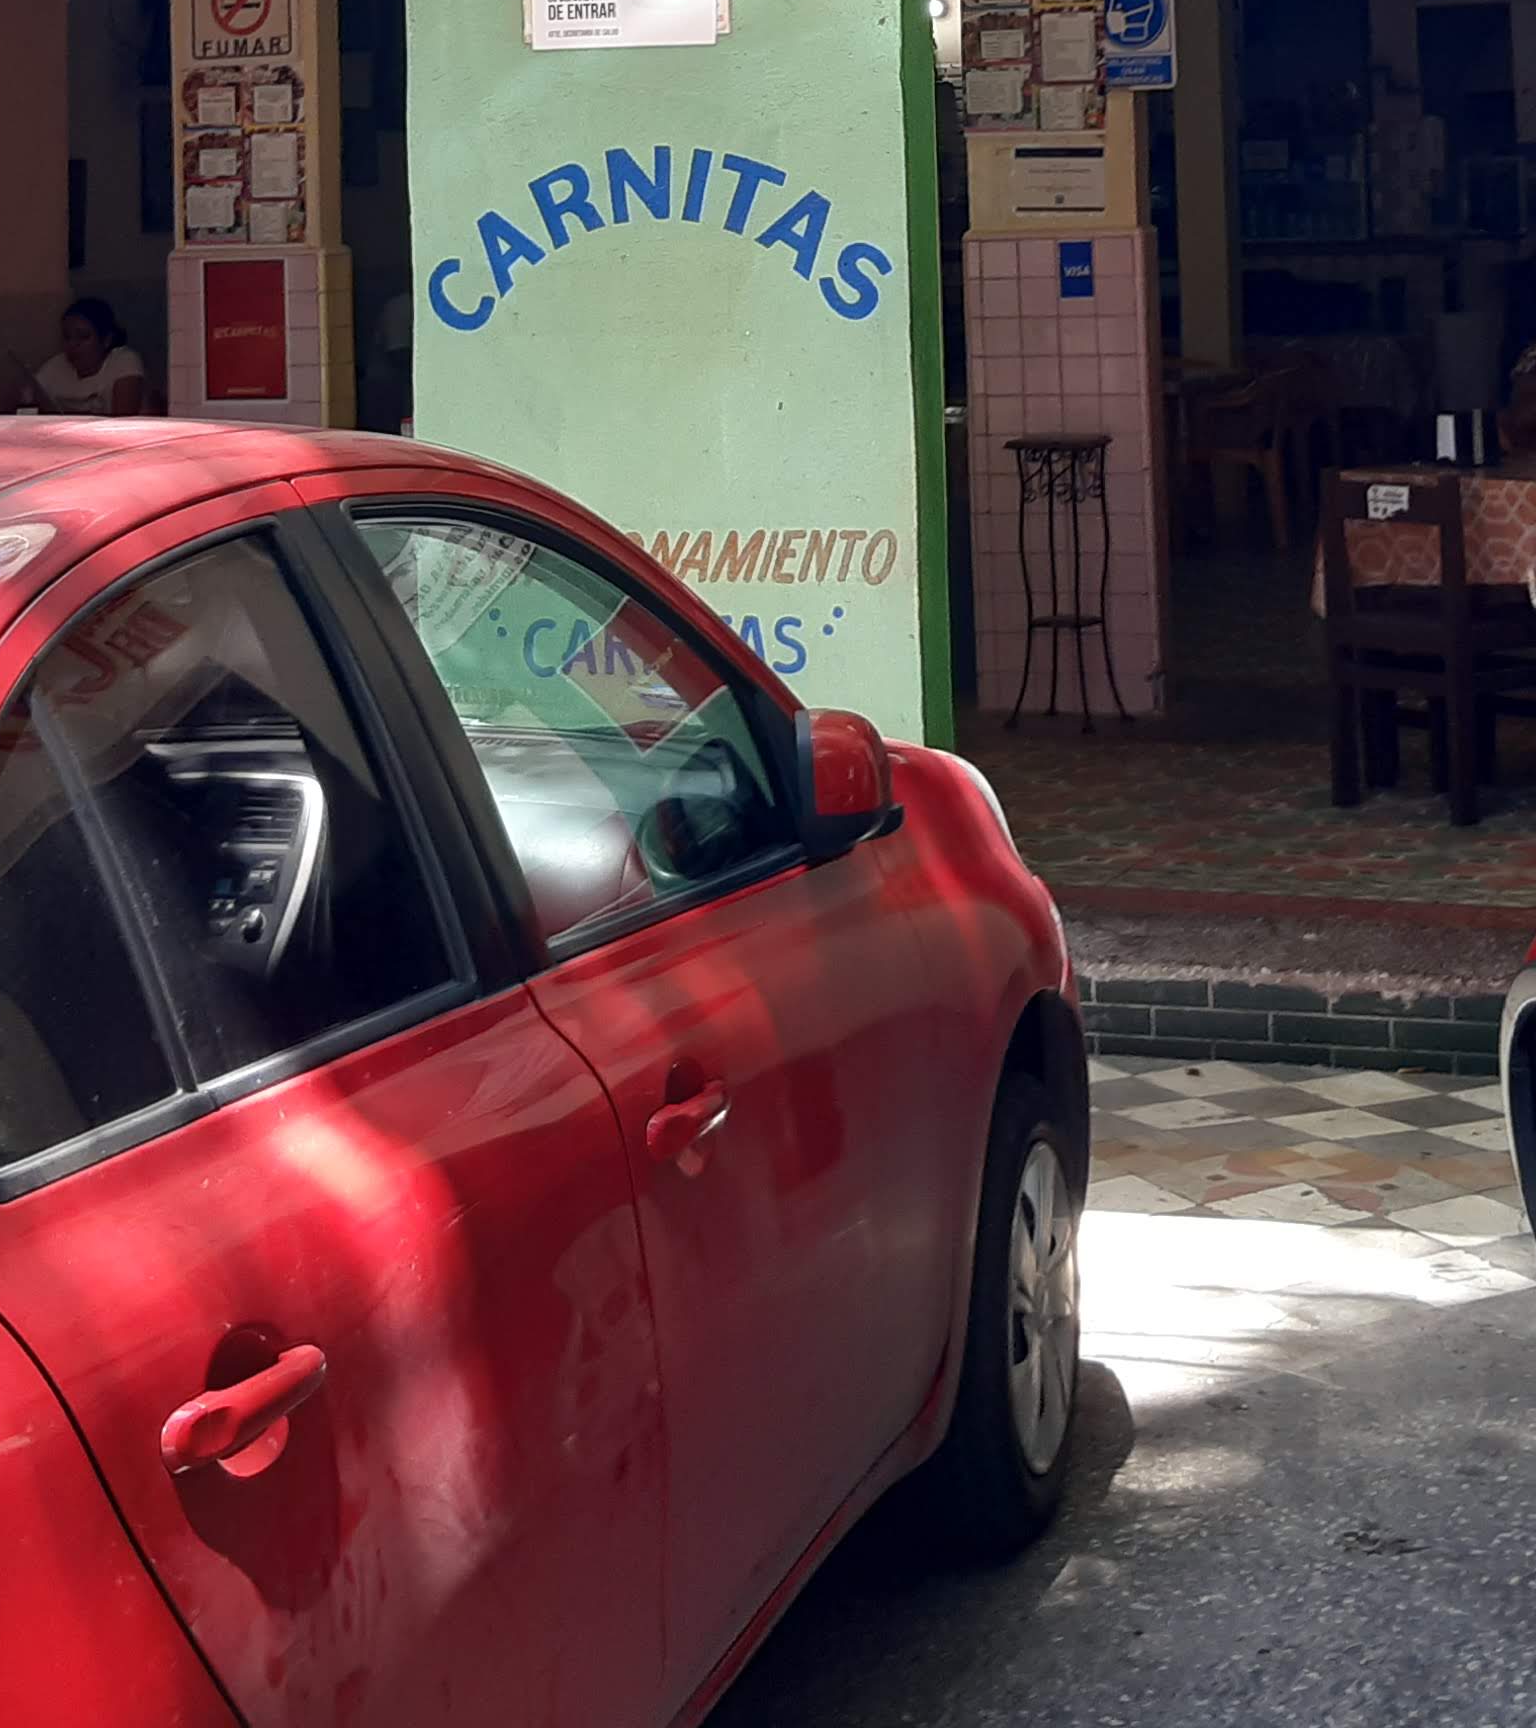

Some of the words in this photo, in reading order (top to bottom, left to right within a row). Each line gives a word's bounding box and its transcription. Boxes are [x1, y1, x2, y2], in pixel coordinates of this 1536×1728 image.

[548, 4, 564, 21] DE
[567, 3, 616, 20] ENTRAR
[202, 37, 282, 57] FUMAR
[428, 145, 893, 333] CARNITAS
[522, 614, 809, 680] CARAS
